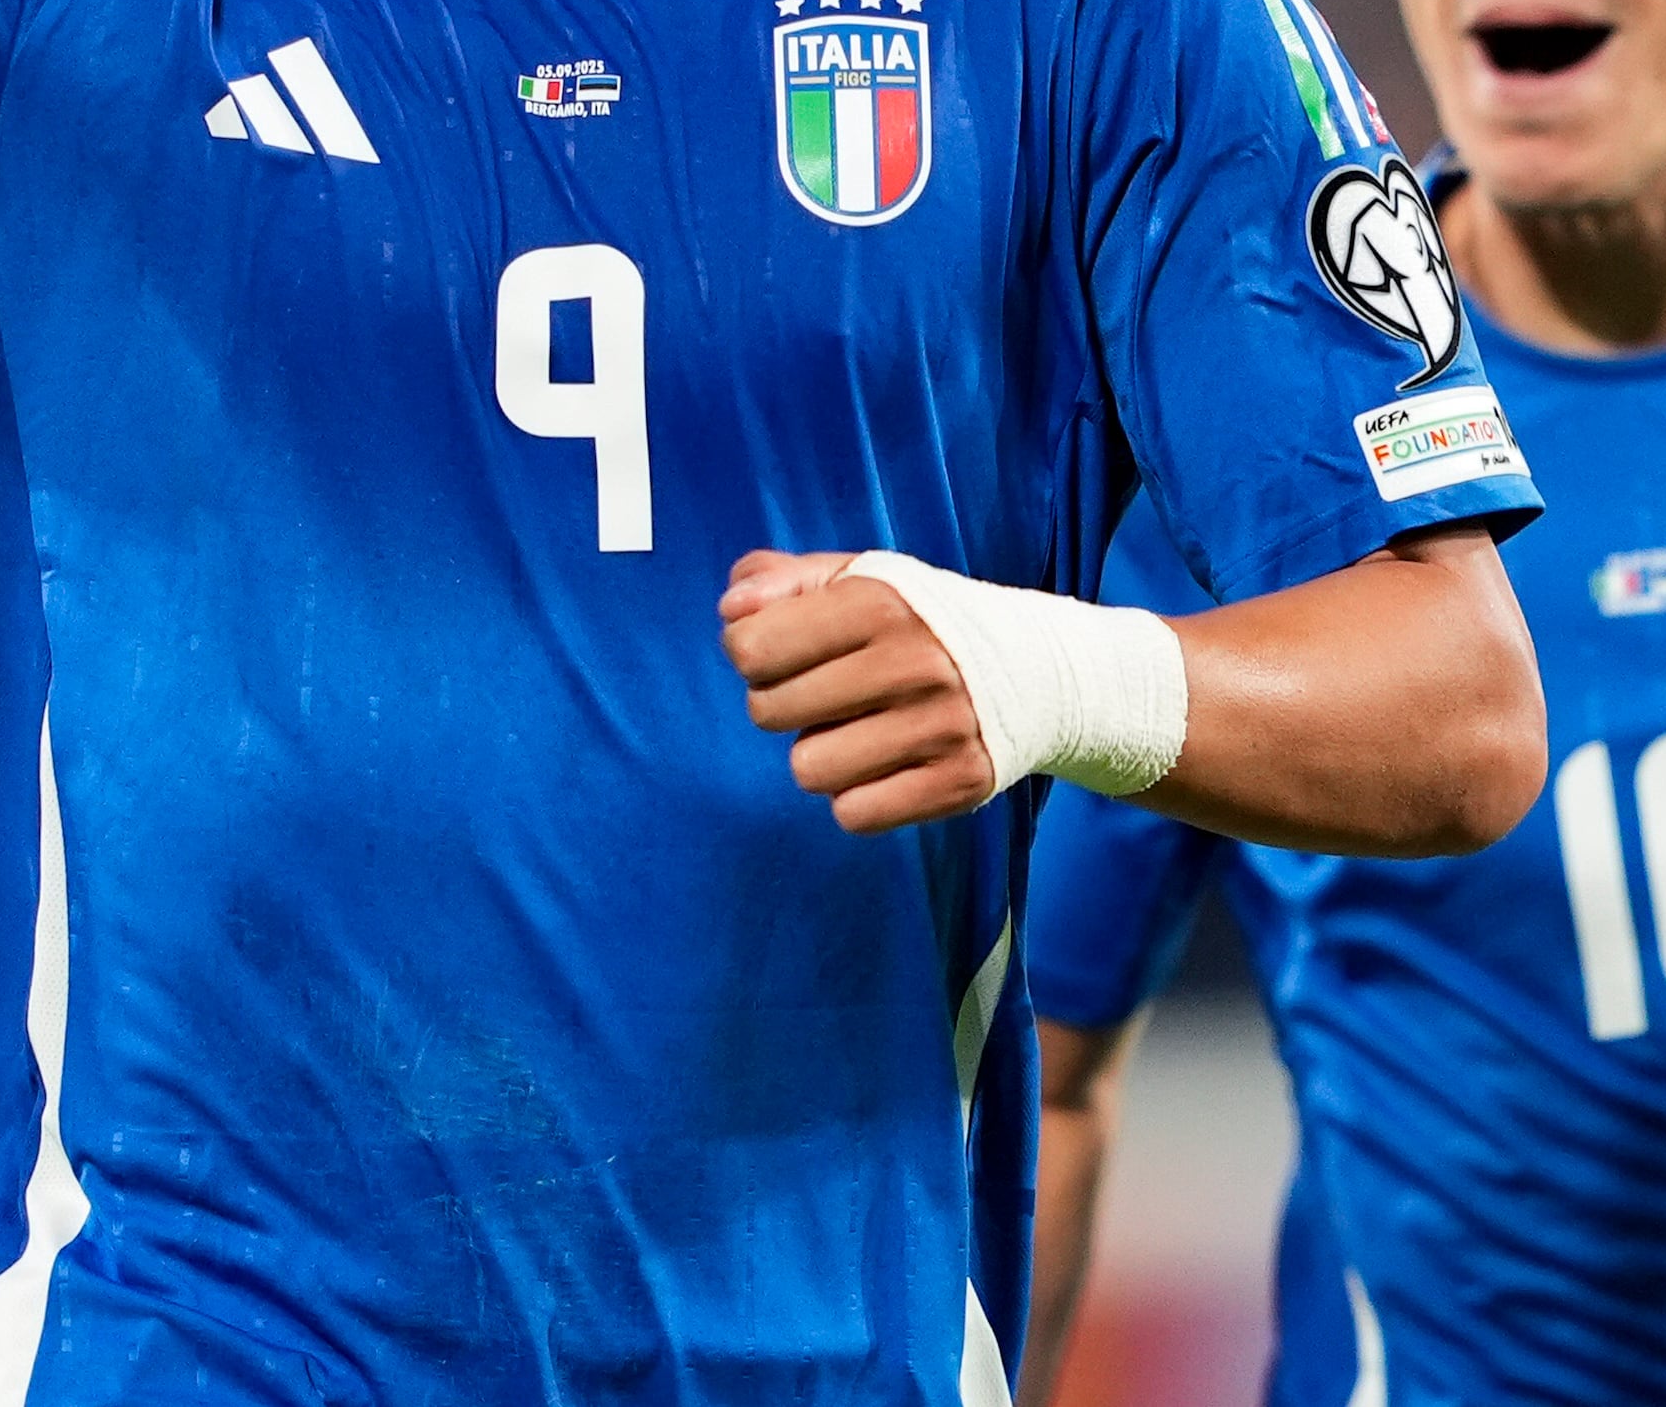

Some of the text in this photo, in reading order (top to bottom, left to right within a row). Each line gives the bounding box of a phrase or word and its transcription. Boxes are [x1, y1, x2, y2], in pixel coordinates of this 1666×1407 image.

[788, 34, 916, 72] ITALIA
[536, 60, 605, 78] 05.09.2025
[834, 72, 871, 87] FIGC
[525, 101, 611, 118] BERGAMO, ITA
[495, 244, 653, 551] 9
[1364, 409, 1411, 435] UEFA
[1371, 419, 1501, 467] FOUNDATION
